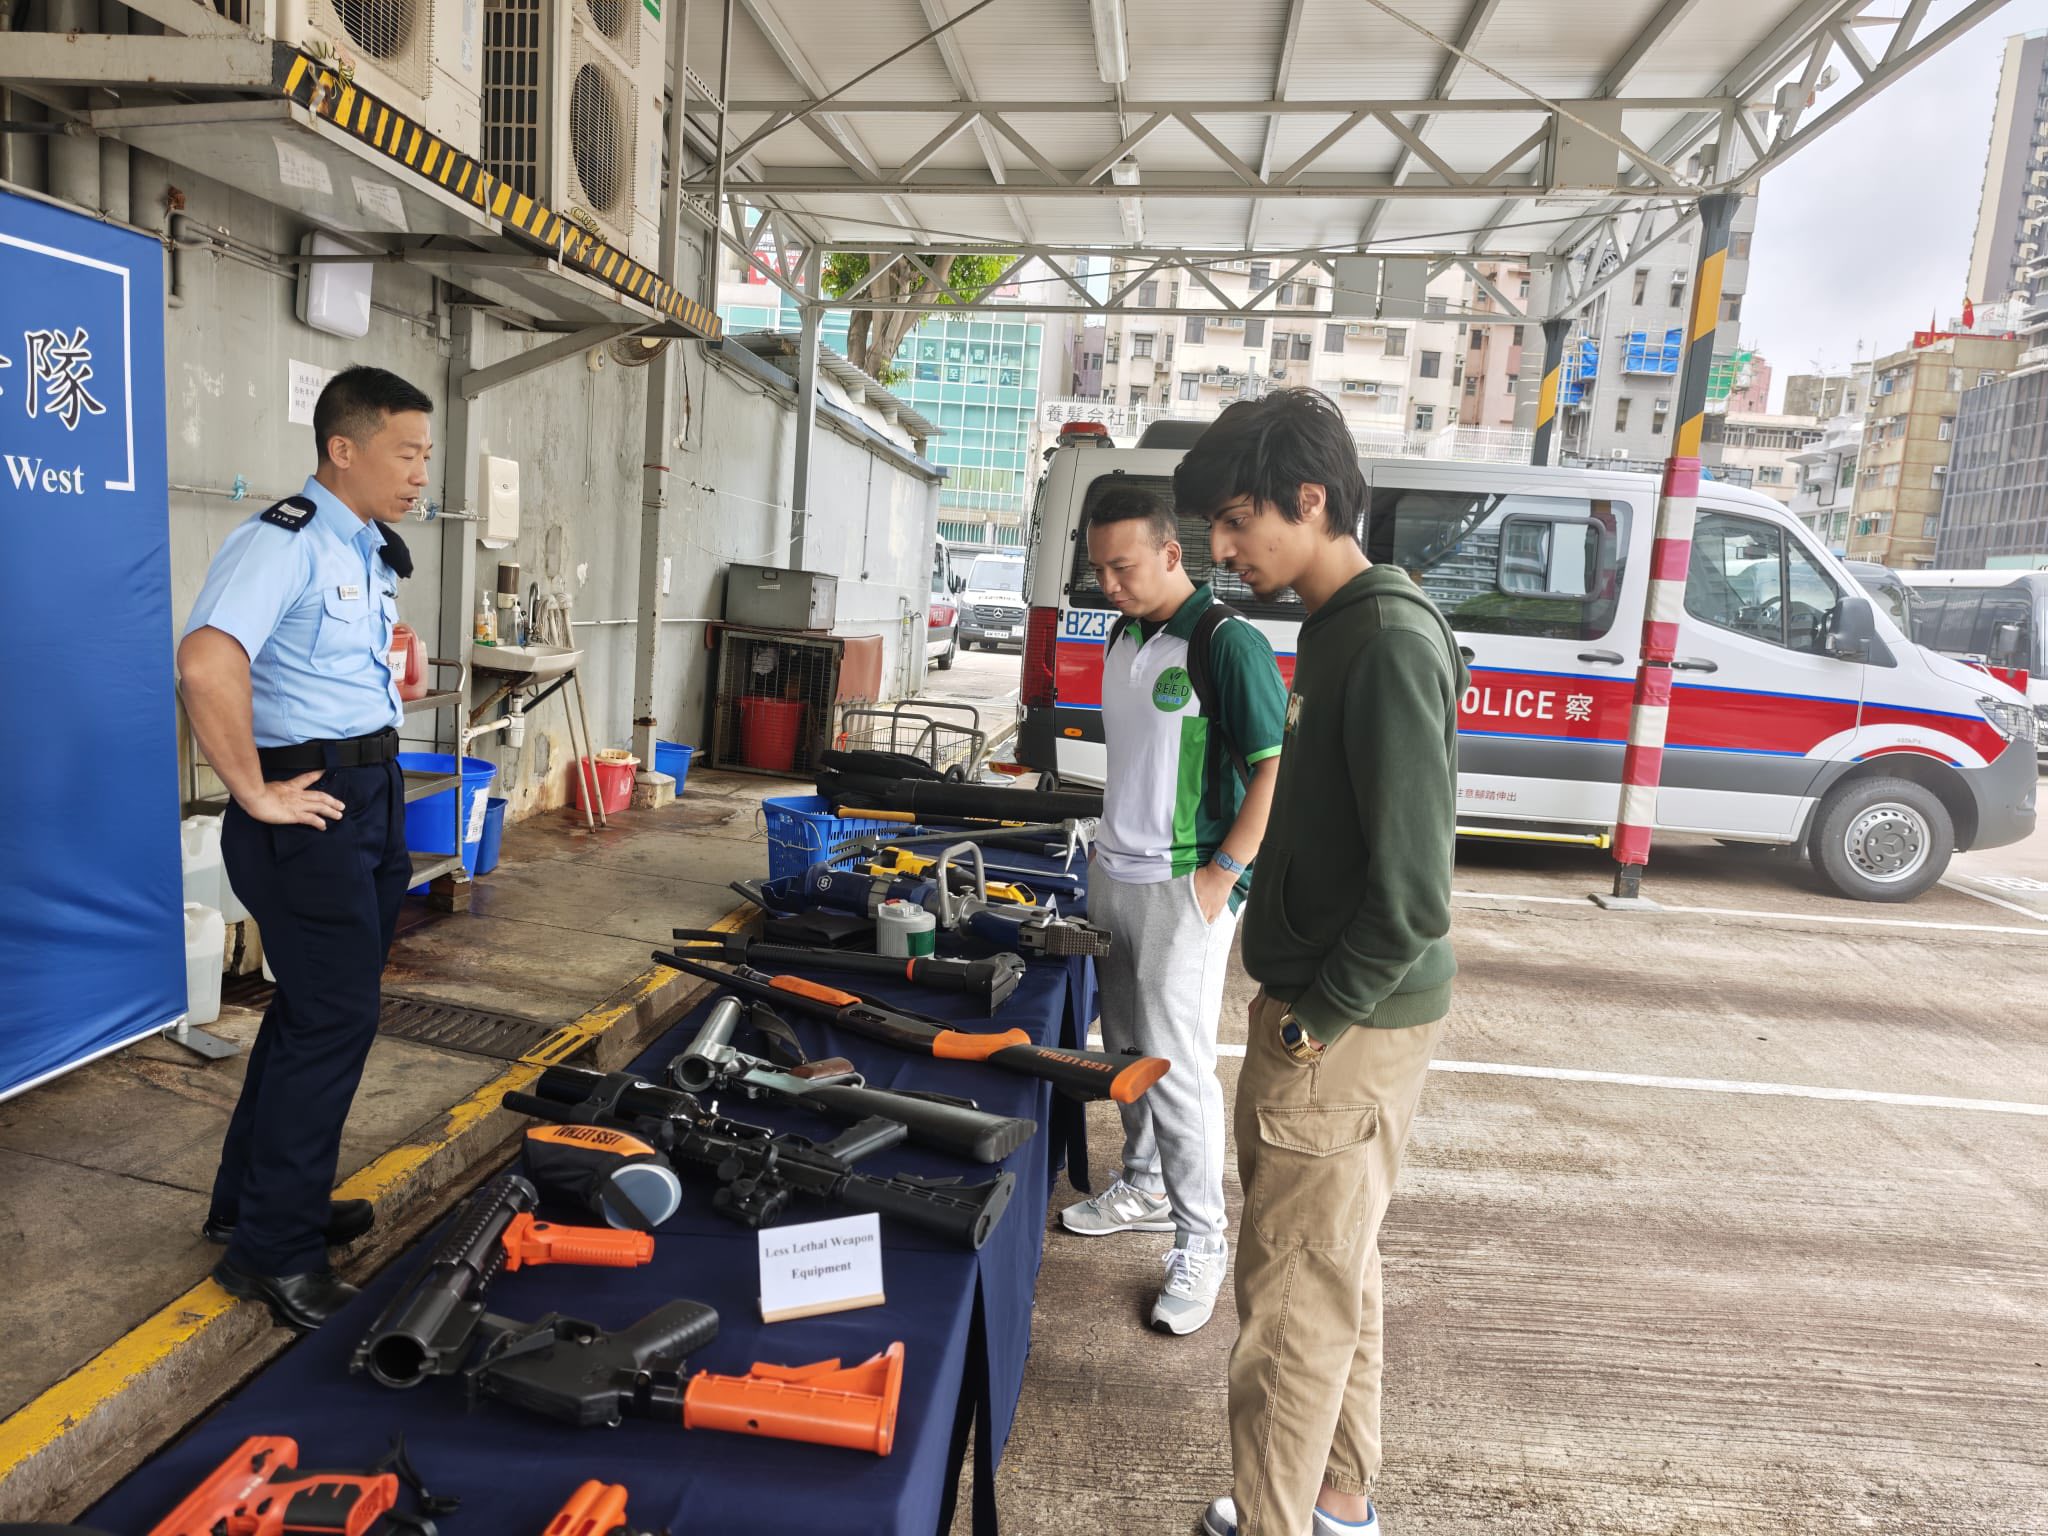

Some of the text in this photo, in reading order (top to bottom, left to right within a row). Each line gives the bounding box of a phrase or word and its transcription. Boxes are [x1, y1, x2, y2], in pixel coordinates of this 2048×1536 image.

[0, 326, 107, 431] 隊
[3, 454, 85, 495] West
[1155, 682, 1190, 697] SEED
[1461, 686, 1594, 722] OLICE 察
[1080, 1059, 1114, 1073] LESS
[765, 1232, 875, 1258] Less Lethal Weapon
[791, 1261, 852, 1281] Equipment
